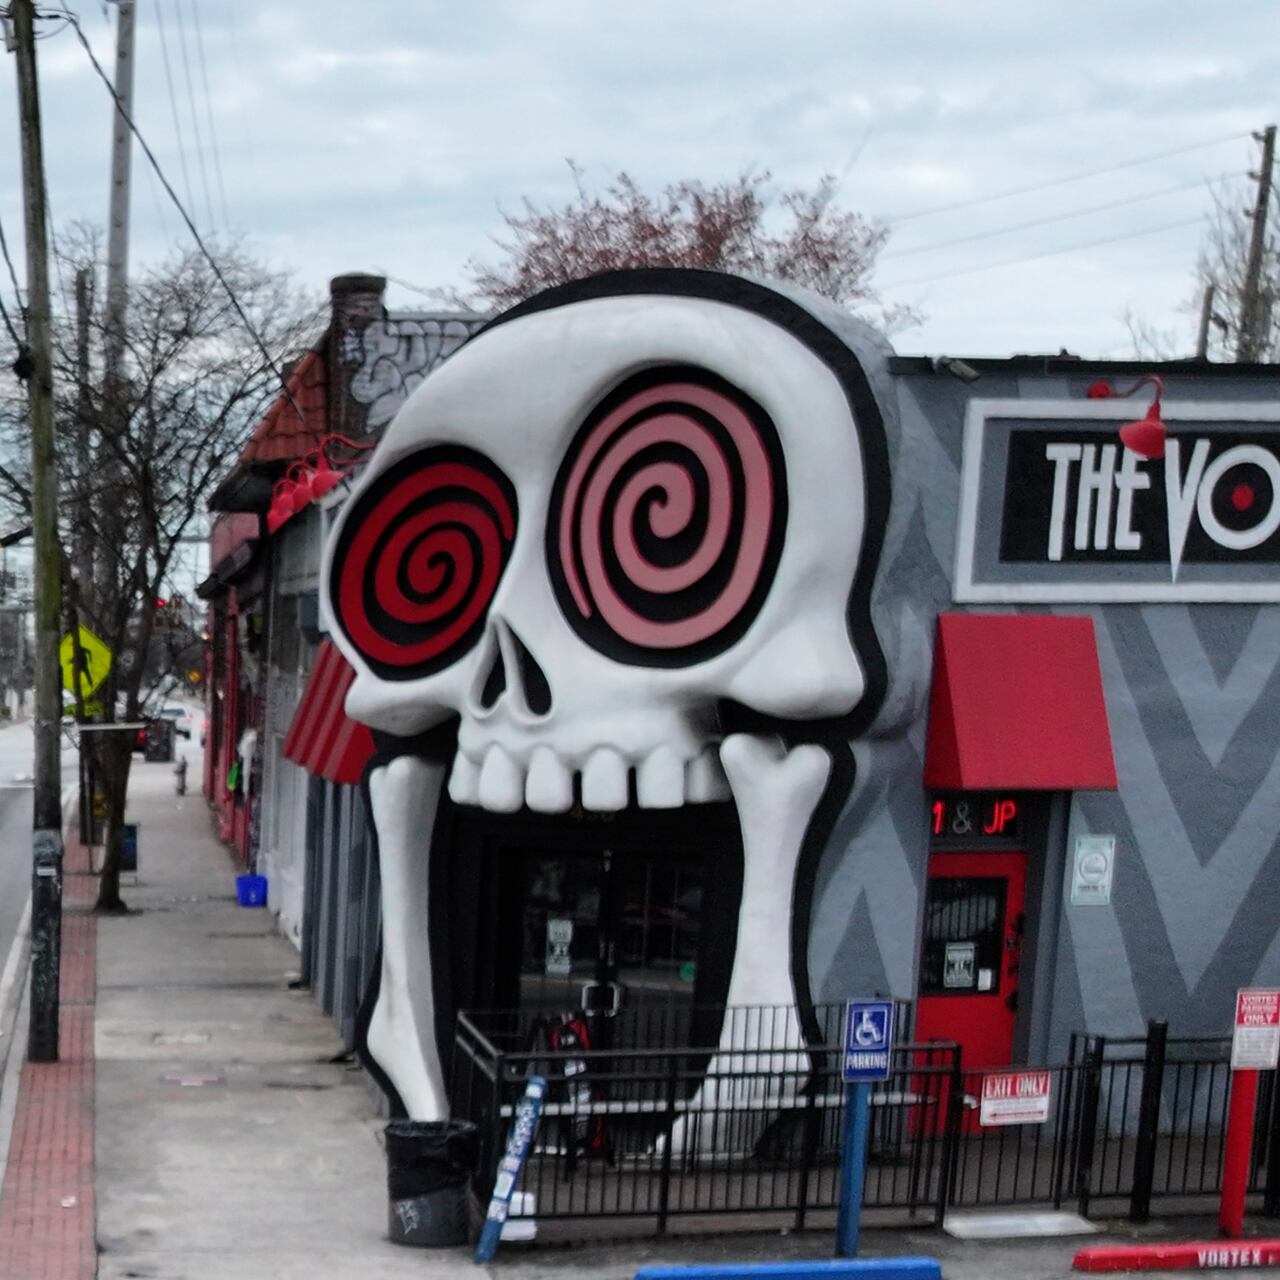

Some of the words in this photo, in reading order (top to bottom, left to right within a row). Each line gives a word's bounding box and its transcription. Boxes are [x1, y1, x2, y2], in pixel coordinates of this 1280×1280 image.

[1046, 443, 1151, 561] THE
[1243, 1012, 1277, 1025] ONLY
[846, 1054, 888, 1070] PARKING
[986, 1075, 1014, 1098] EXIT
[1016, 1074, 1048, 1097] ONLY
[1198, 1248, 1261, 1268] VORTEX
